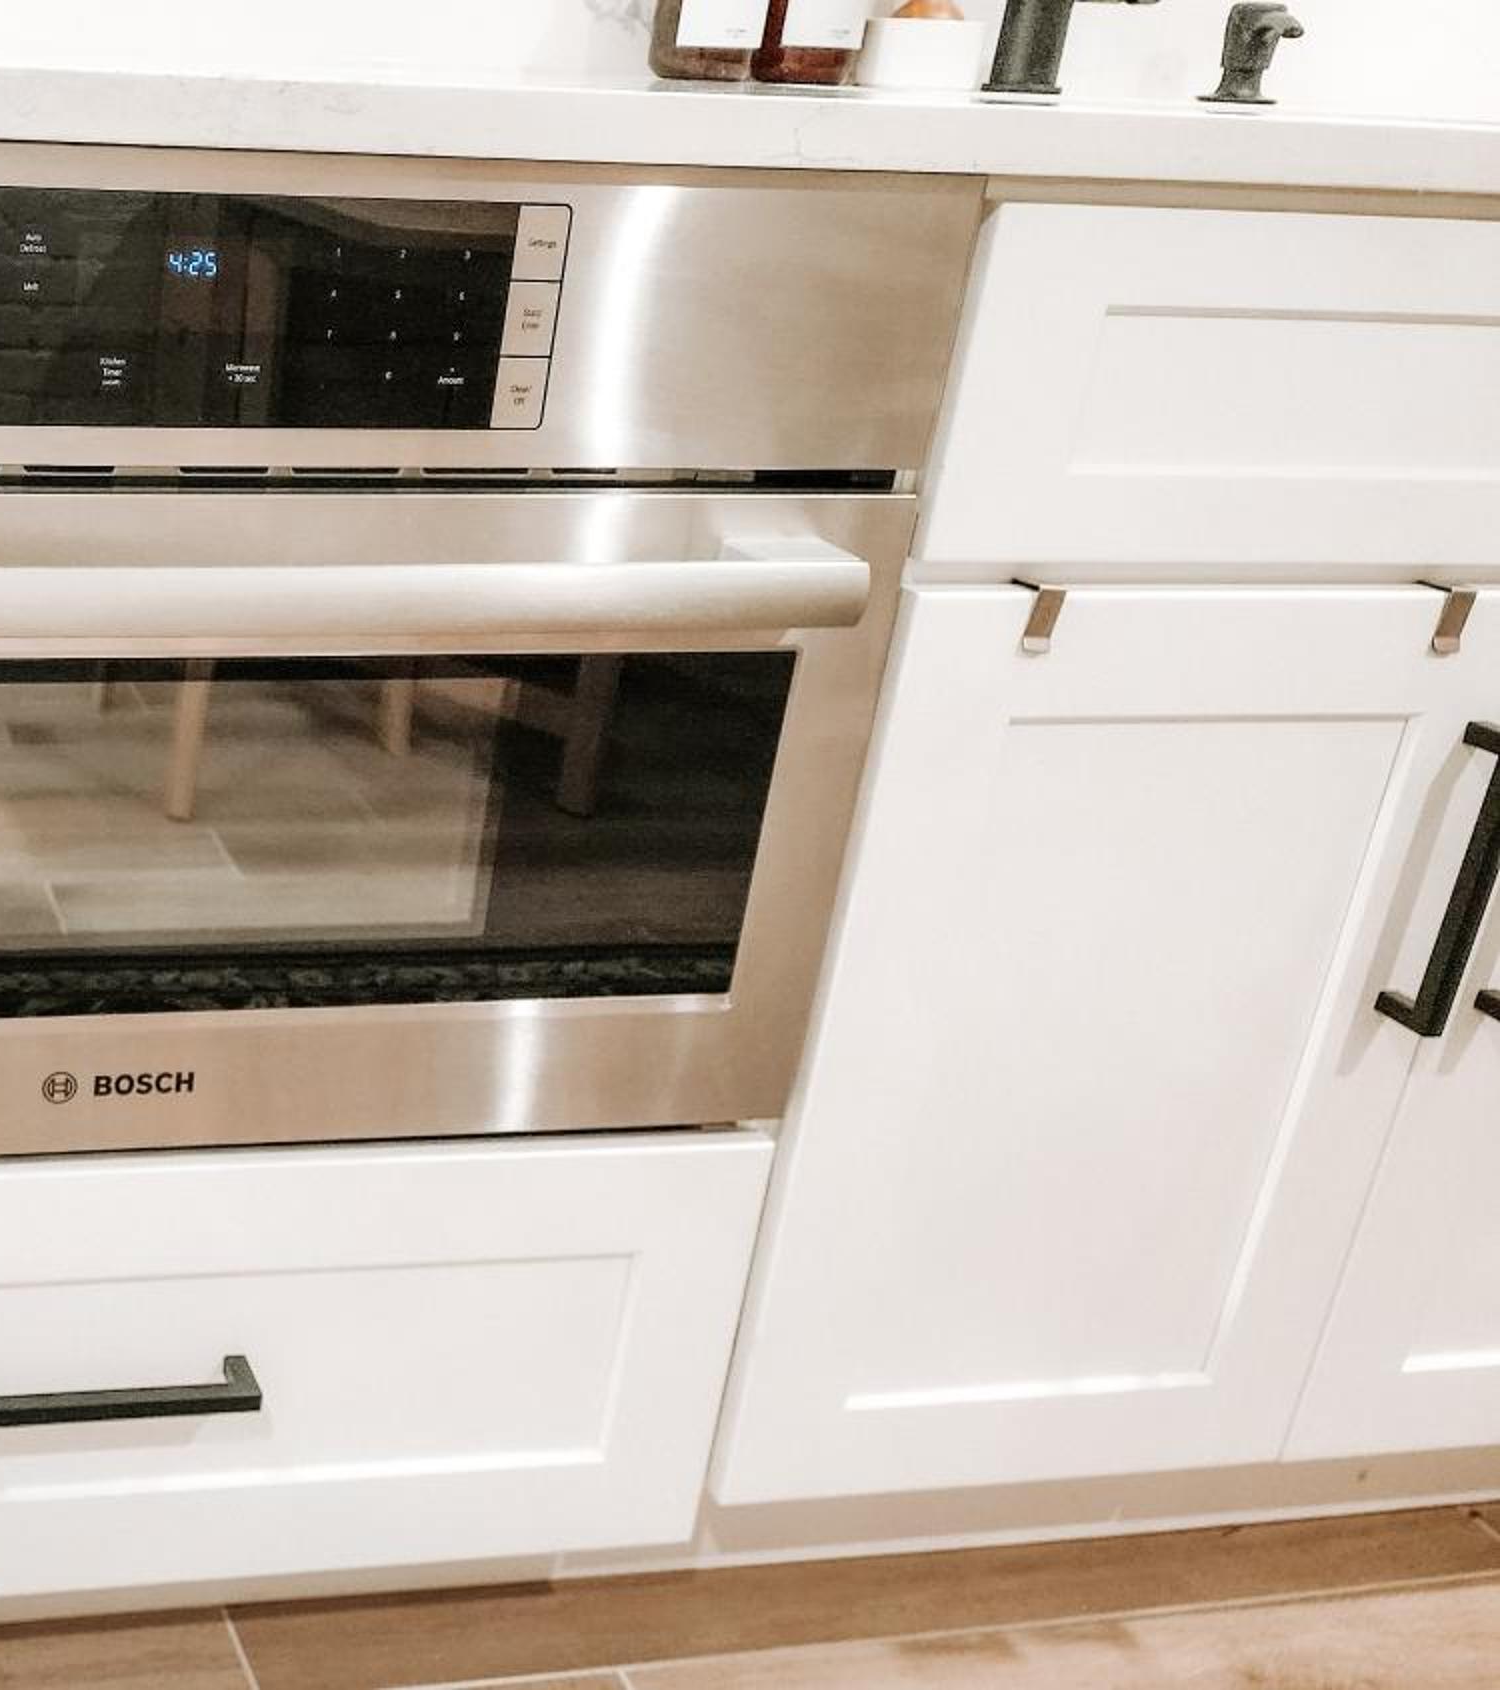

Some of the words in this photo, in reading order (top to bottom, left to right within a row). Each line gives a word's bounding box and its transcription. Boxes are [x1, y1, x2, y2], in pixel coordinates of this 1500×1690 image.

[169, 252, 217, 275] 4:25
[437, 376, 465, 385] Amount
[93, 1071, 195, 1097] BOSCH
